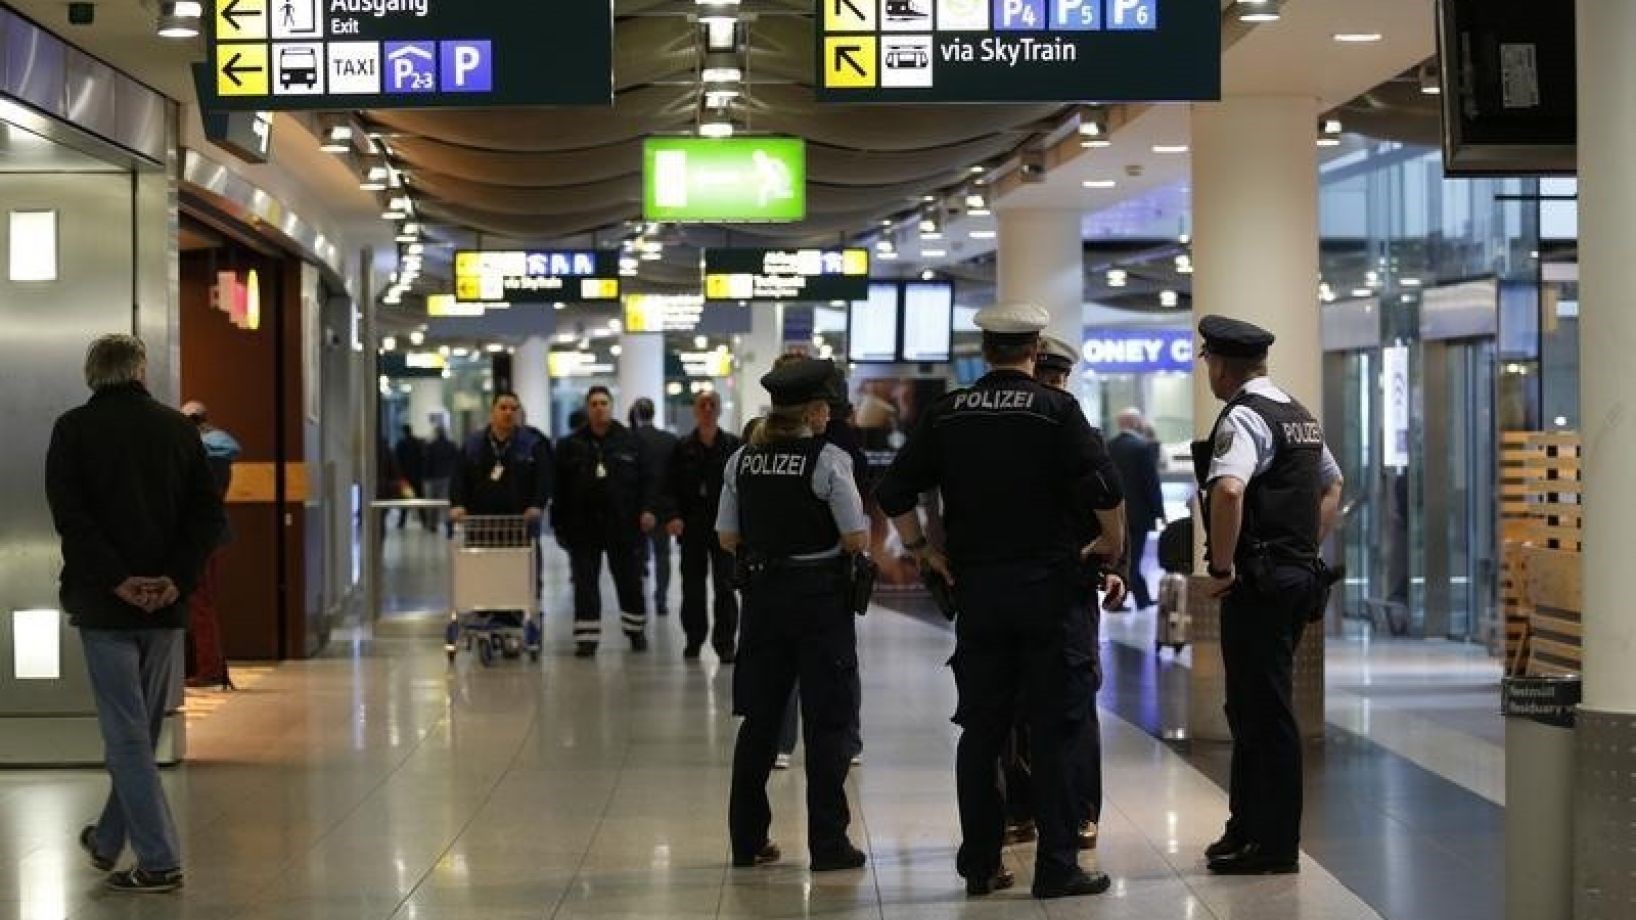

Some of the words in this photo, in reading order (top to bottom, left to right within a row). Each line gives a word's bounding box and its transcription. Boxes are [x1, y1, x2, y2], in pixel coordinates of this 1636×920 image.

[330, 0, 428, 16] Ausgang
[332, 18, 359, 34] Exit
[941, 37, 974, 61] via
[980, 37, 1077, 66] SkyTrain
[333, 59, 374, 76] TAXI
[455, 46, 480, 86] P
[1083, 339, 1163, 362] ONEY
[1170, 339, 1192, 362] C
[953, 390, 1034, 409] POLIZEI
[1282, 422, 1321, 443] POLIZE
[740, 453, 807, 476] POLIZEI
